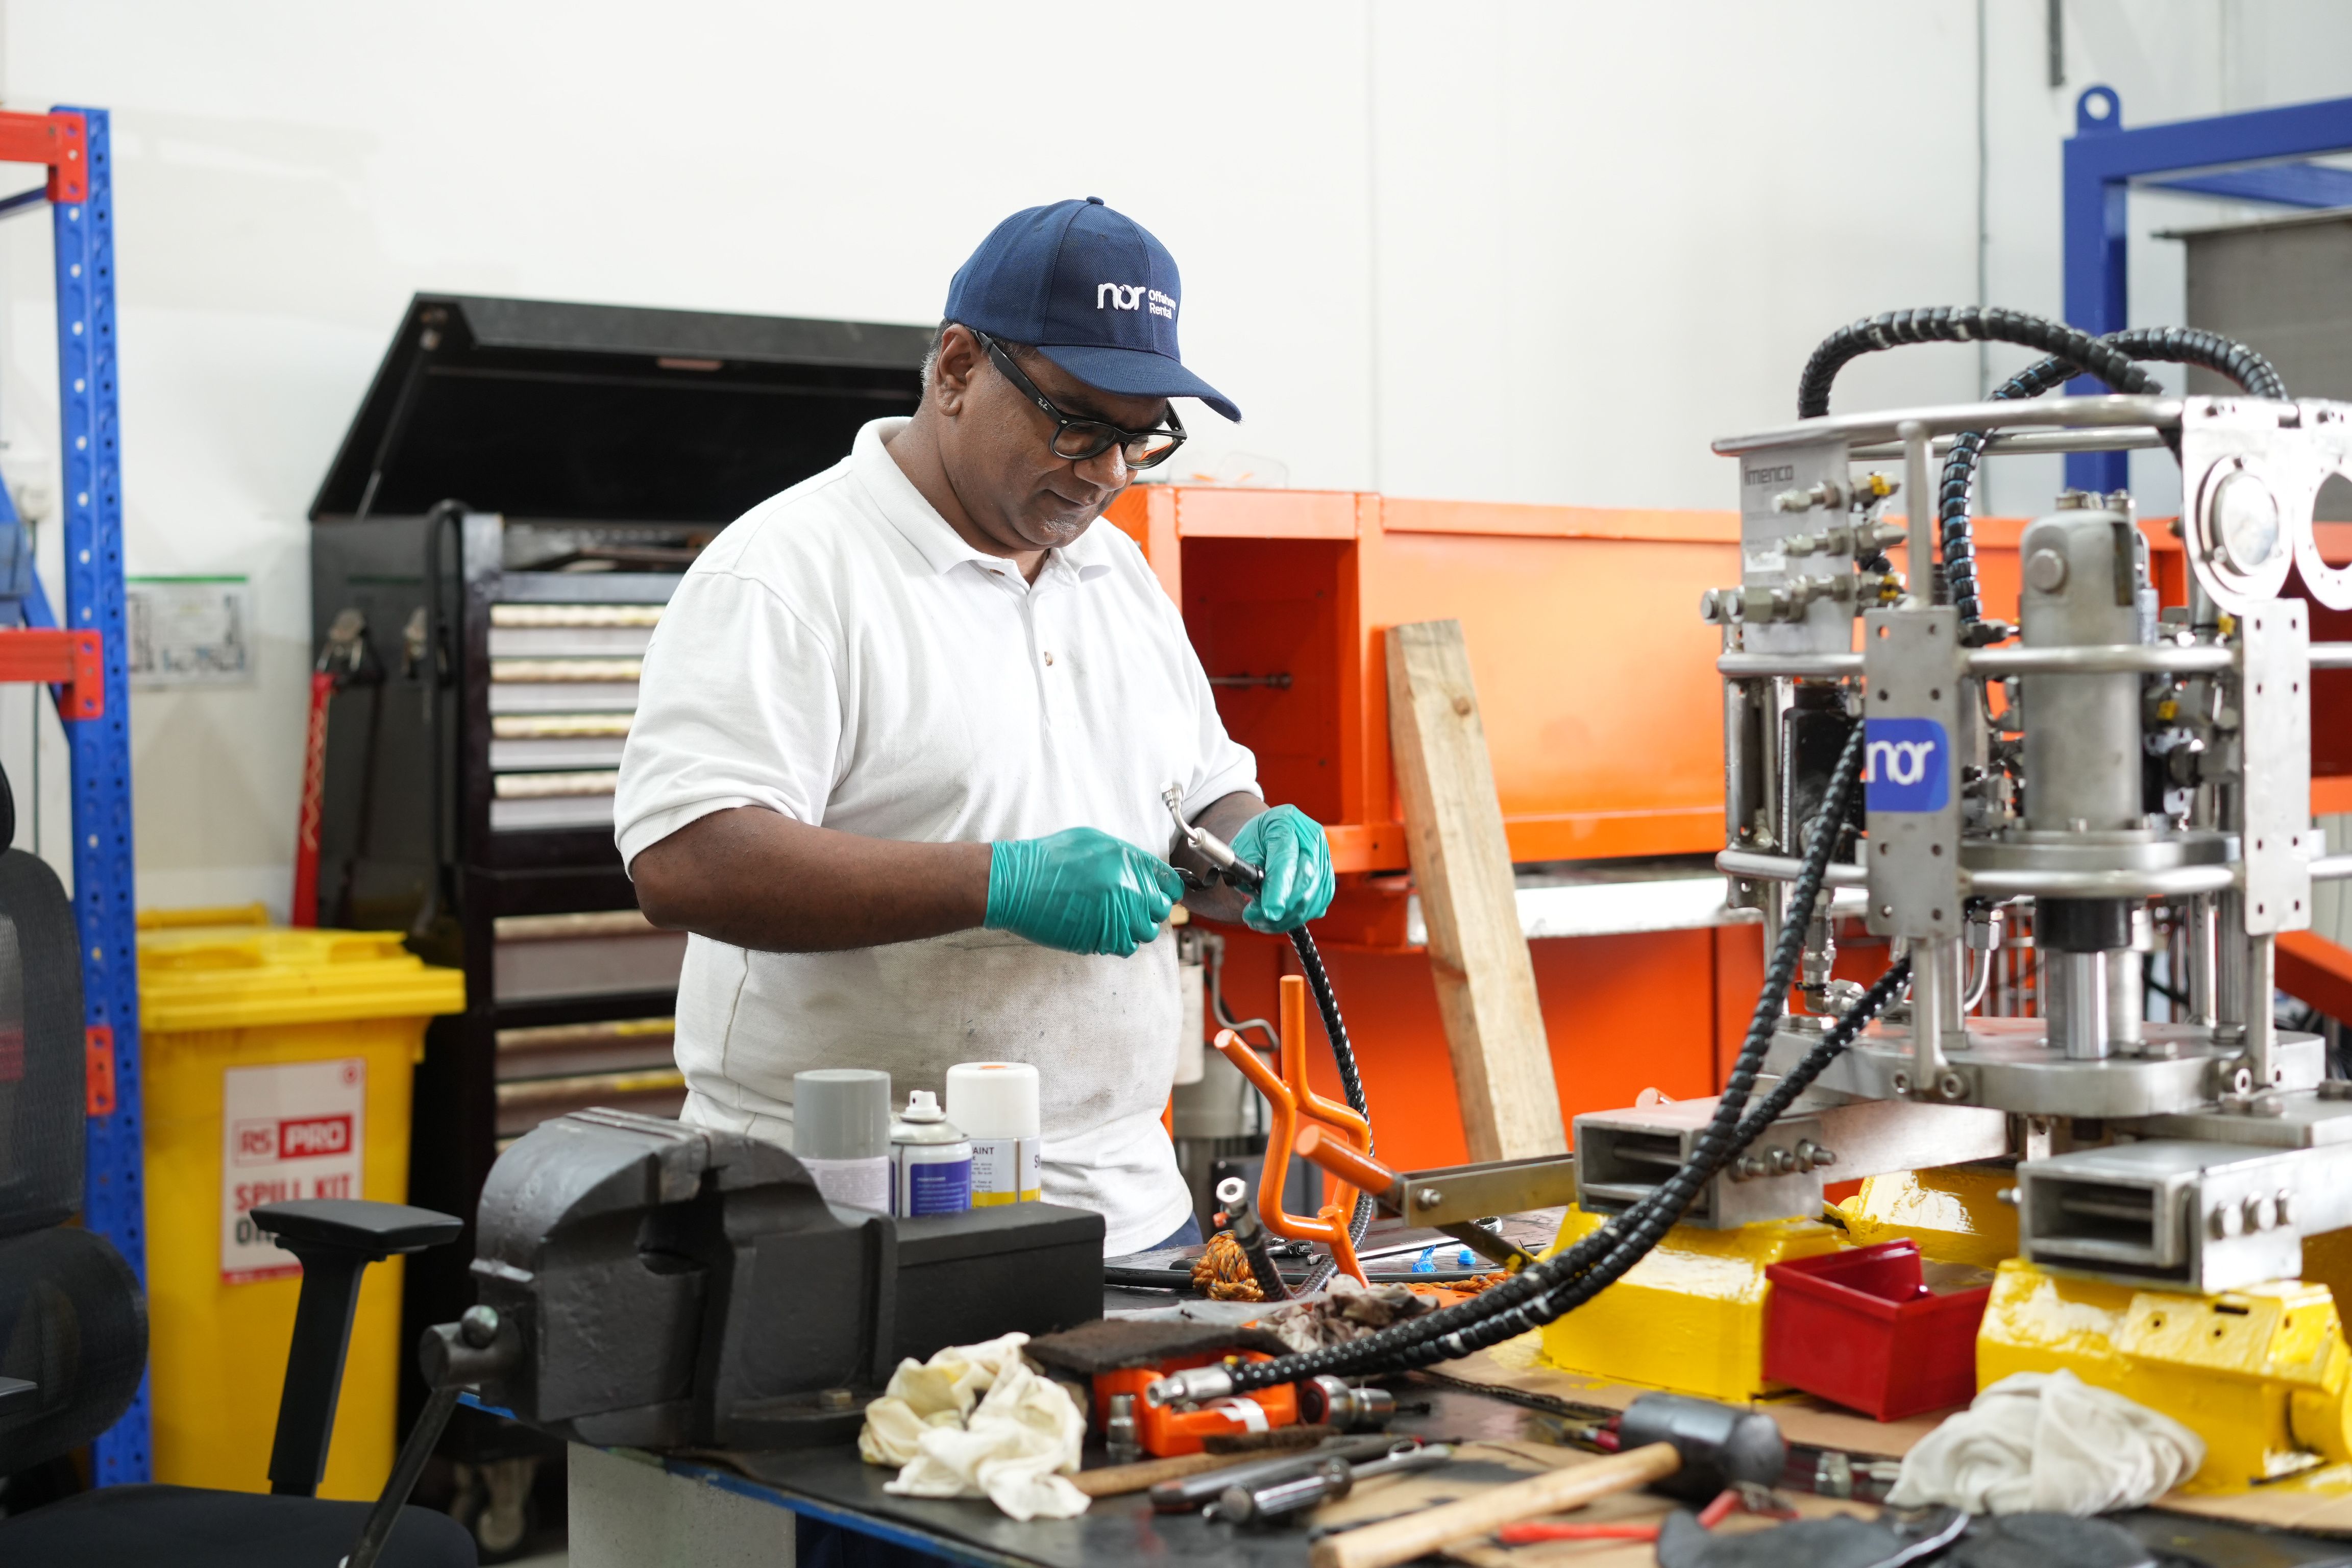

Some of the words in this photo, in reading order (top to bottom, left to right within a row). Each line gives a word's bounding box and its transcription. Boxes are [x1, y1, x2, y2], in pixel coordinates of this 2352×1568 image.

[1097, 283, 1146, 310] nor
[1149, 302, 1172, 320] Rental
[1866, 740, 1935, 786] nor
[241, 1129, 272, 1156] RS
[284, 1120, 348, 1157] PRO
[972, 1147, 995, 1155] AINT
[314, 1174, 353, 1199] KIT
